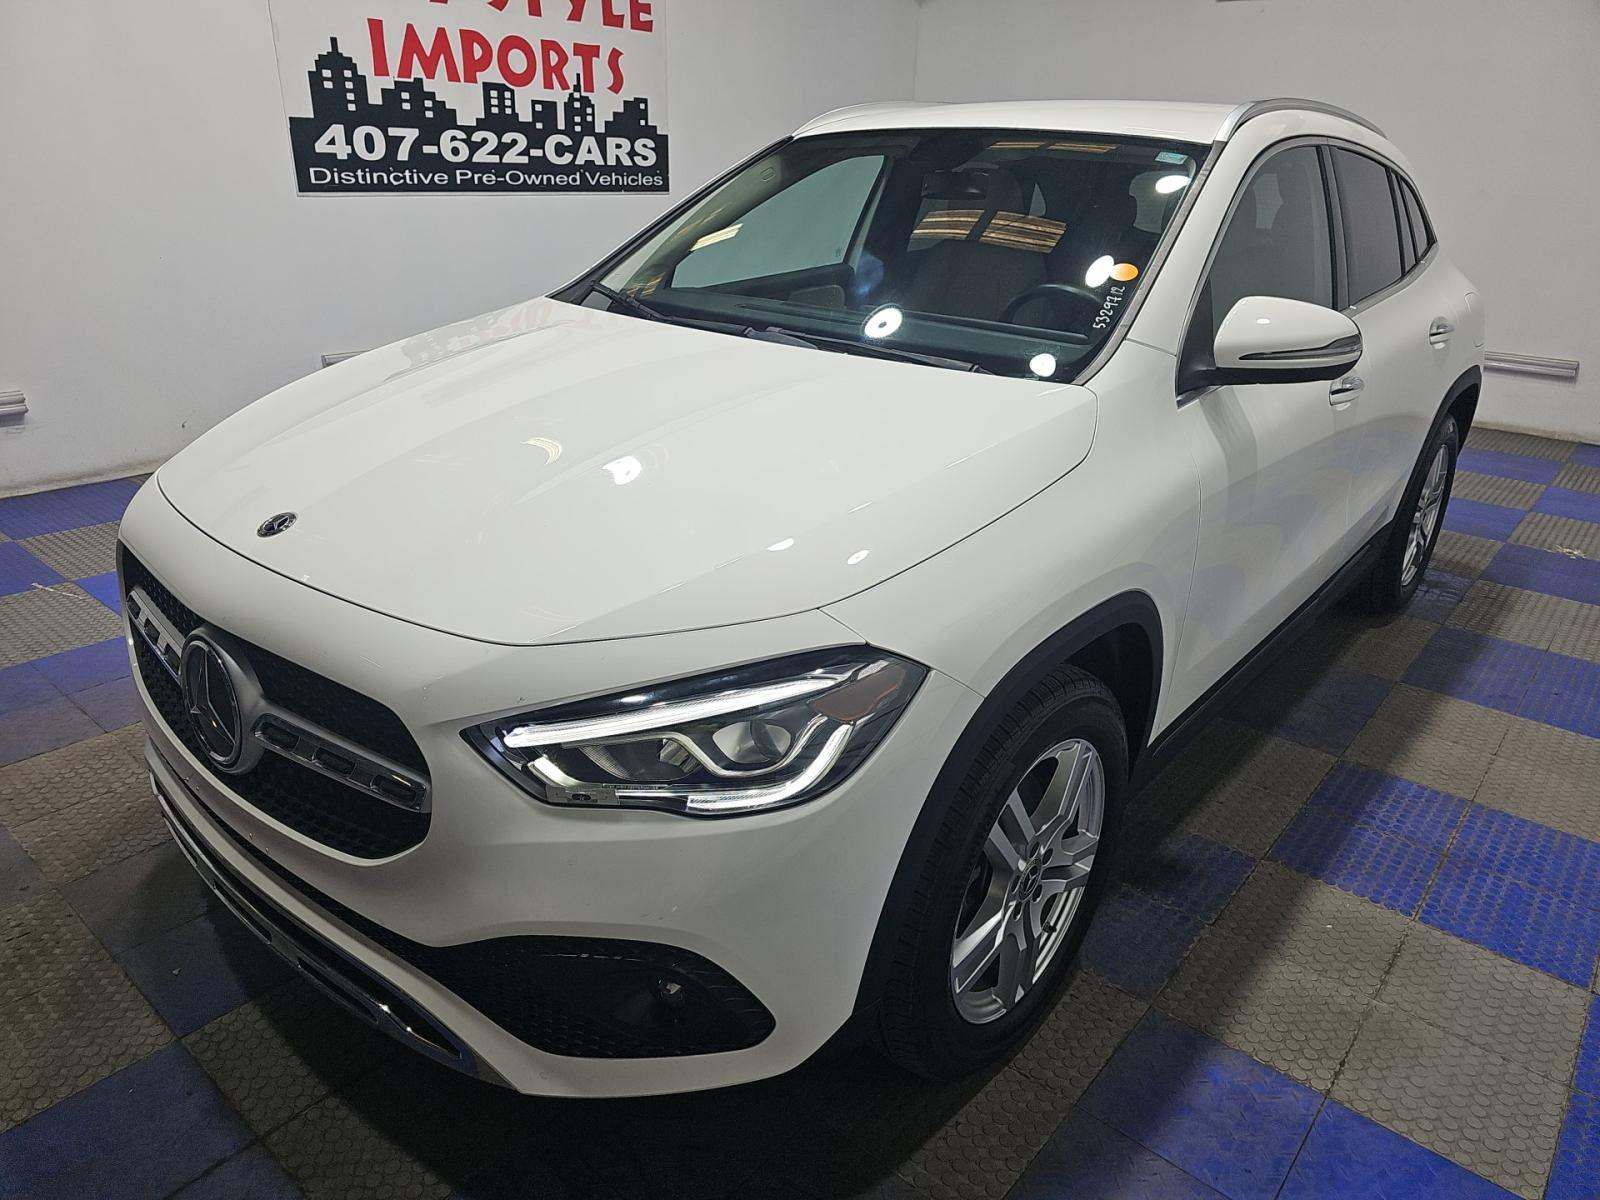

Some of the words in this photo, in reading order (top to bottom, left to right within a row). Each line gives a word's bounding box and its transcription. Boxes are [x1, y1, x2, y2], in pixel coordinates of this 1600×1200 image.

[367, 18, 625, 95] IMPORTS
[314, 123, 657, 166] 407-622-CARS
[309, 166, 449, 186] Distinctive
[456, 169, 581, 186] Pre-Owned
[585, 172, 663, 186] Vehicles
